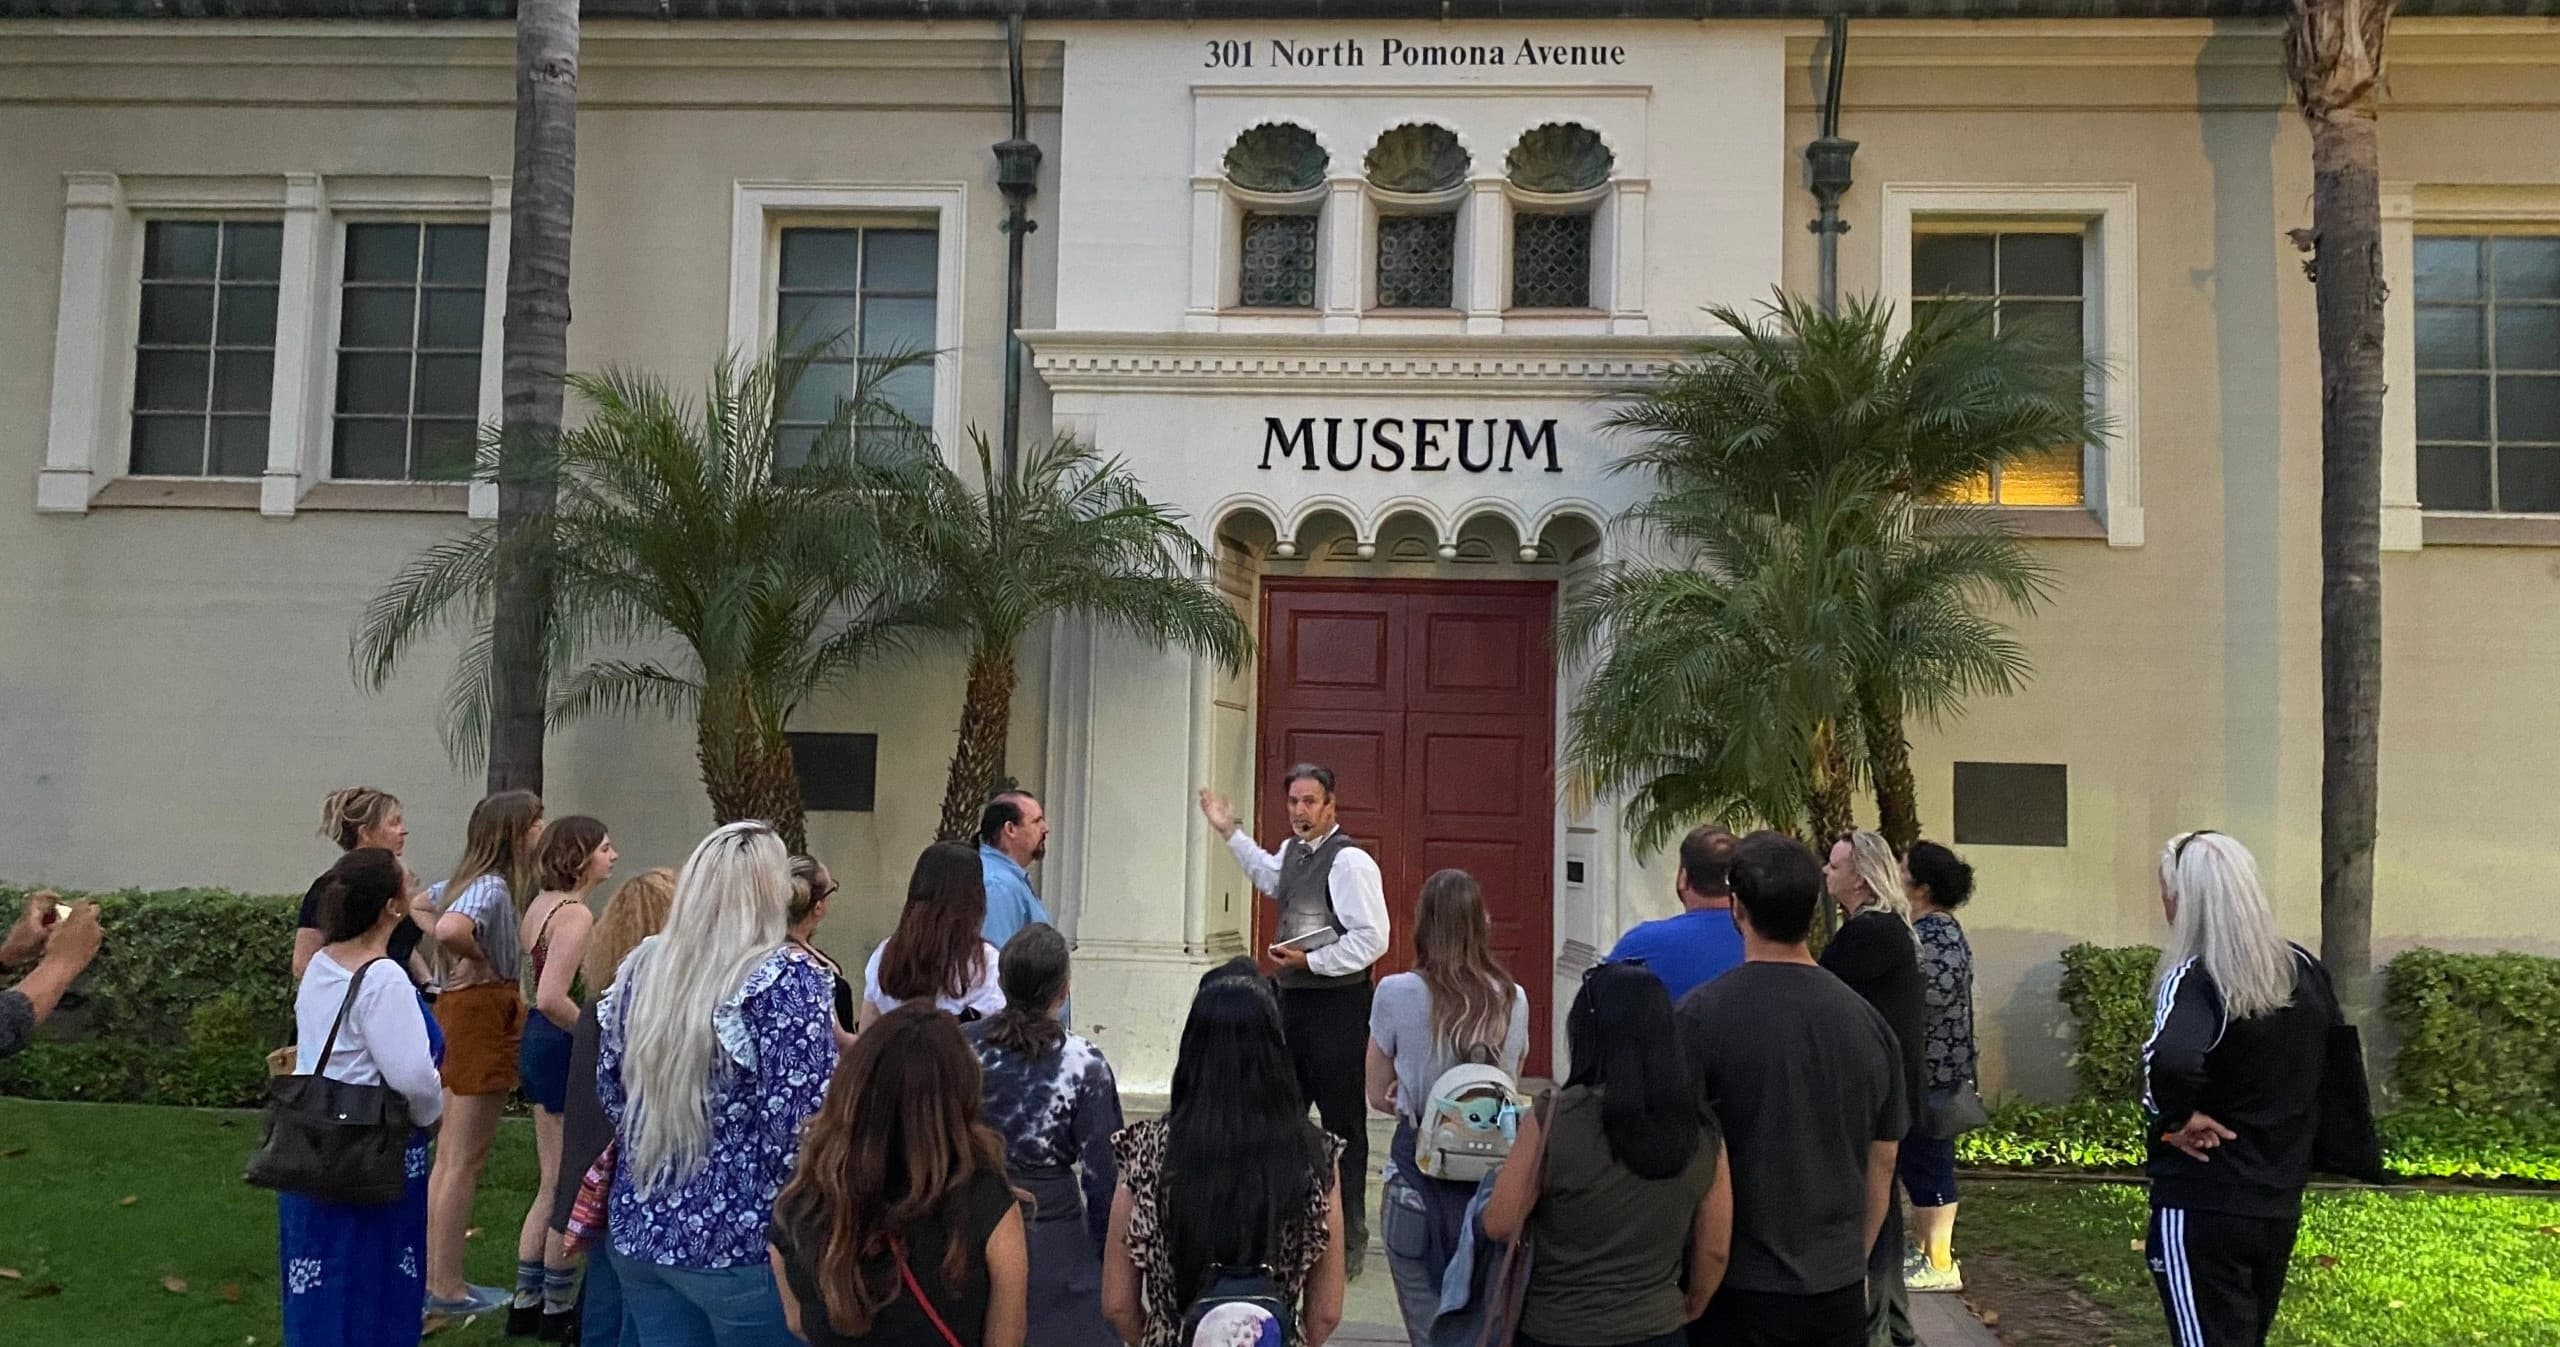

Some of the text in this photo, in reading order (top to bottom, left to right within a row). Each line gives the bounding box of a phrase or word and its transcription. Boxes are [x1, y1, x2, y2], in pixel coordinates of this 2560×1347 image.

[1203, 38, 1625, 68] 301 North Pomona Avenue
[1258, 417, 1563, 473] MUSEUM
